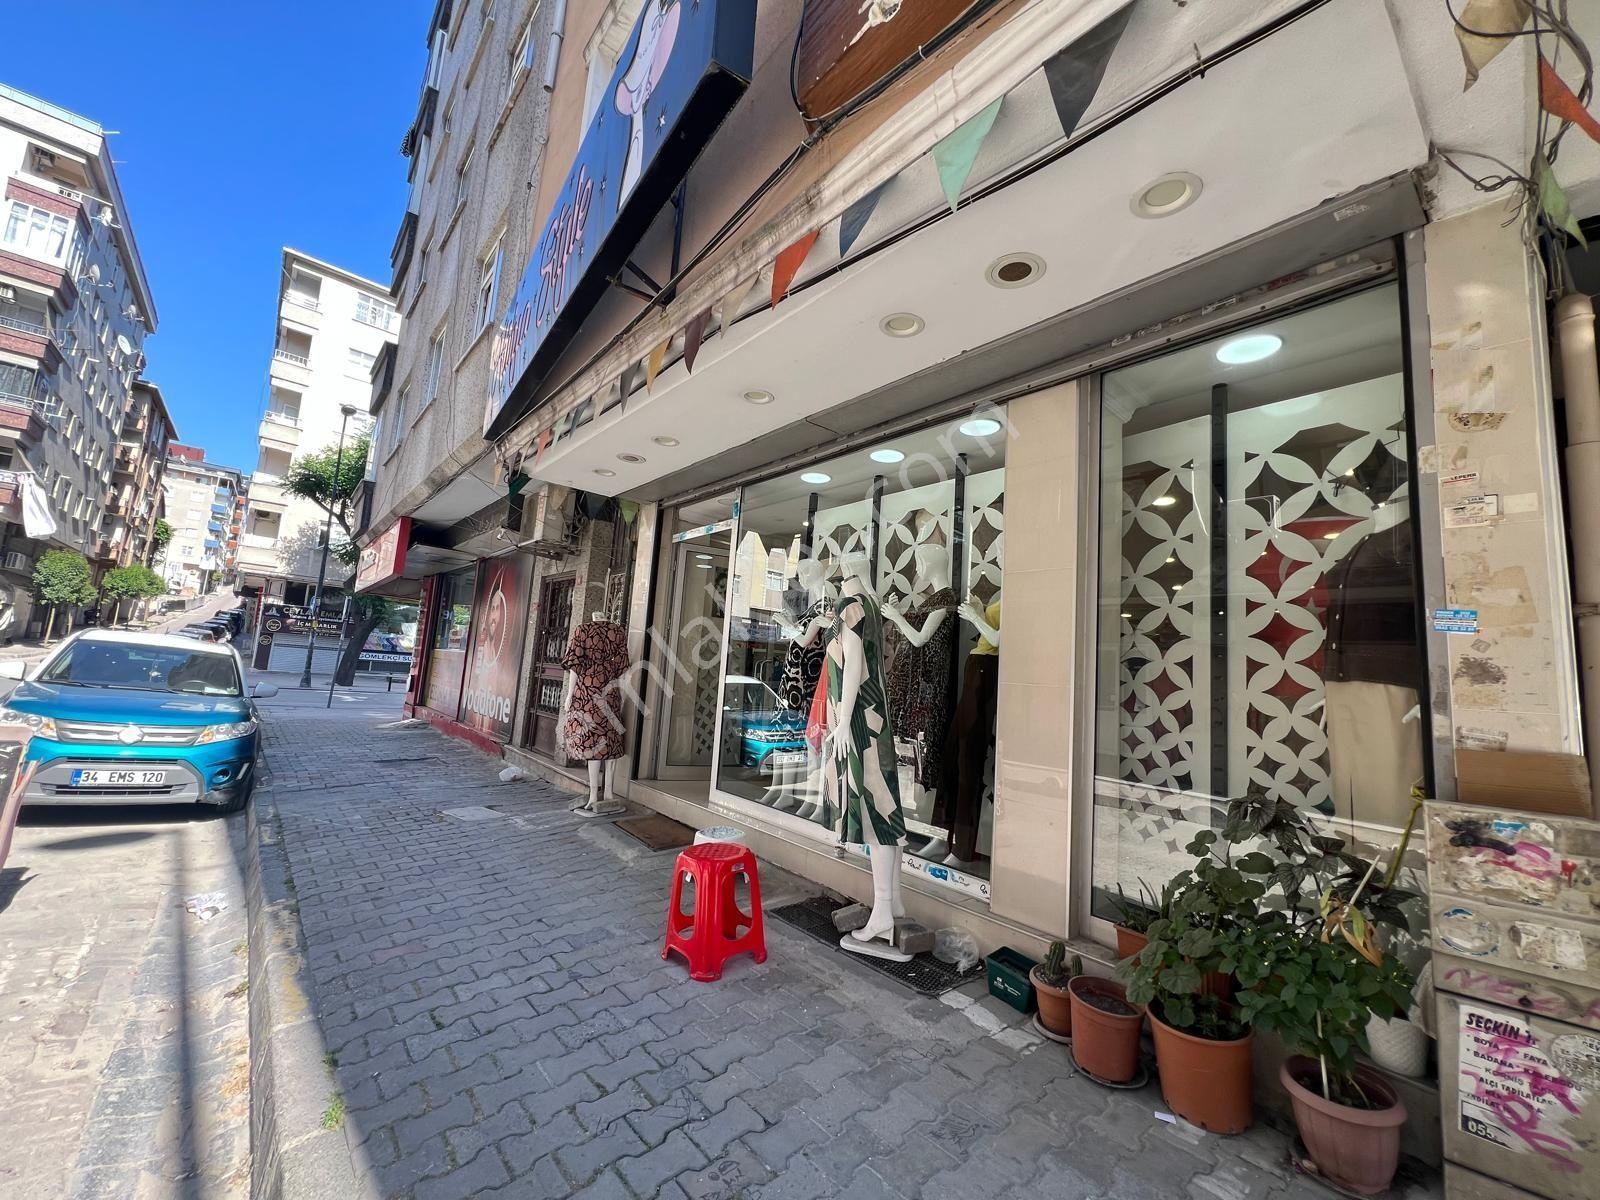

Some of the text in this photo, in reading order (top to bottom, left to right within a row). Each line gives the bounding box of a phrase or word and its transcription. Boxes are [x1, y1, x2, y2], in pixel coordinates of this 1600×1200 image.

[283, 606, 316, 616] CEYLA
[320, 610, 345, 619] EMLA
[305, 621, 338, 629] MARLIK
[462, 685, 511, 724] vodafone
[82, 771, 164, 783] 34 EMS 120
[1466, 1012, 1520, 1040] SEÇKİN
[1473, 1036, 1500, 1051] BOYA
[1473, 1050, 1514, 1069] BADANA
